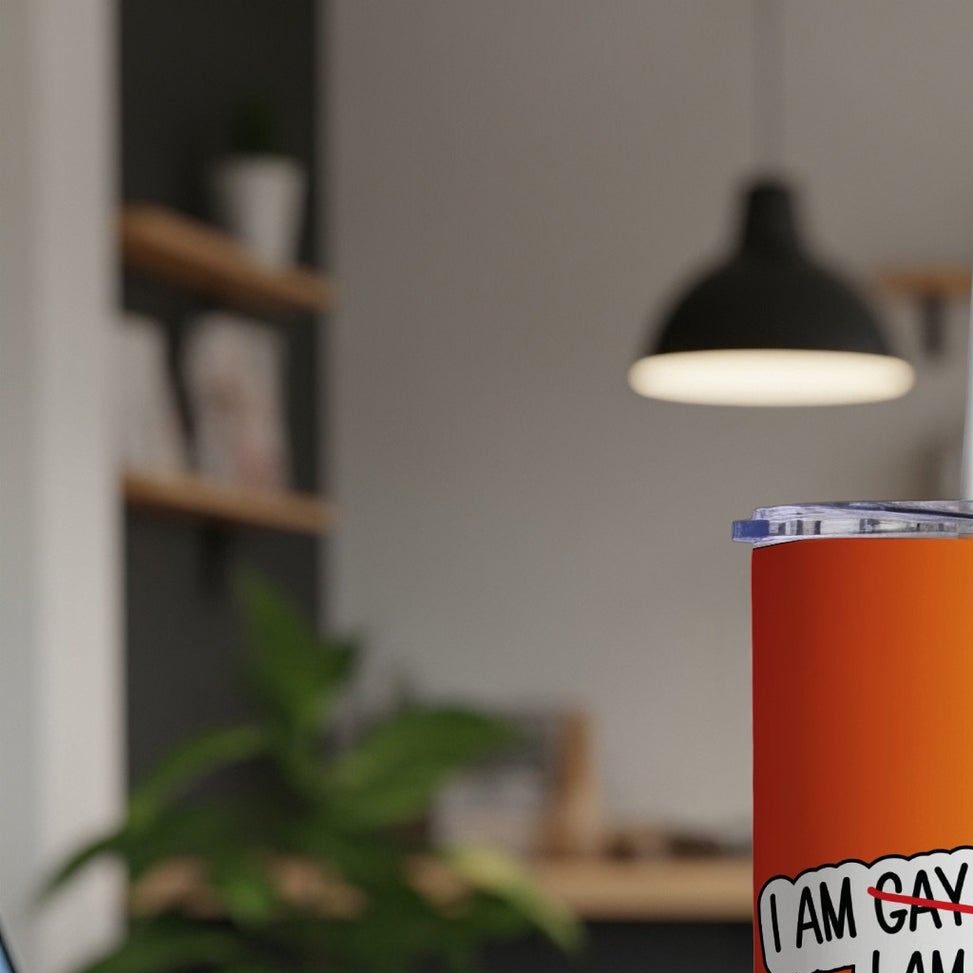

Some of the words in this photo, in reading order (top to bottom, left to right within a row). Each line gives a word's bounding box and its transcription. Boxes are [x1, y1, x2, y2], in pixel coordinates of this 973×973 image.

[769, 893, 782, 953] I
[795, 876, 858, 949] AM
[873, 862, 969, 935] GAY
